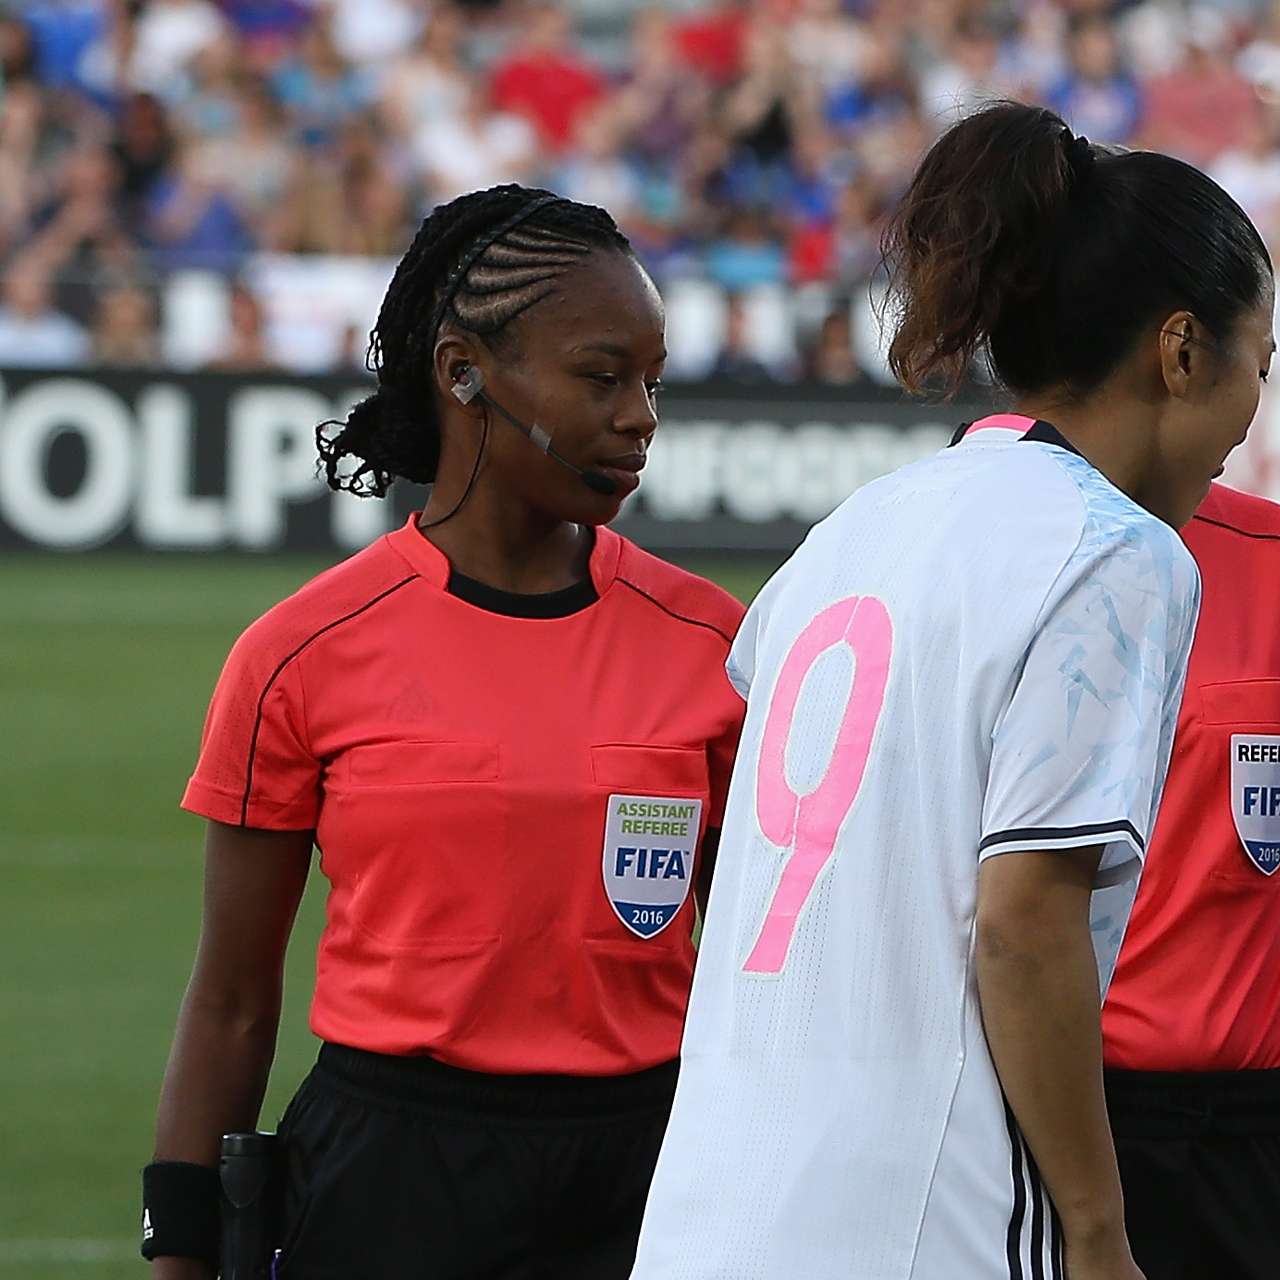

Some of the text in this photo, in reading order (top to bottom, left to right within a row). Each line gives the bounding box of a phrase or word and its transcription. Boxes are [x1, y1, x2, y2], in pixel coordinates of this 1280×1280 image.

[741, 595, 894, 975] 9
[616, 803, 696, 819] ASSISTANT
[621, 819, 689, 837] REFEREE
[1258, 847, 1280, 862] 2016
[615, 847, 686, 880] FIFA
[632, 909, 664, 925] 2016
